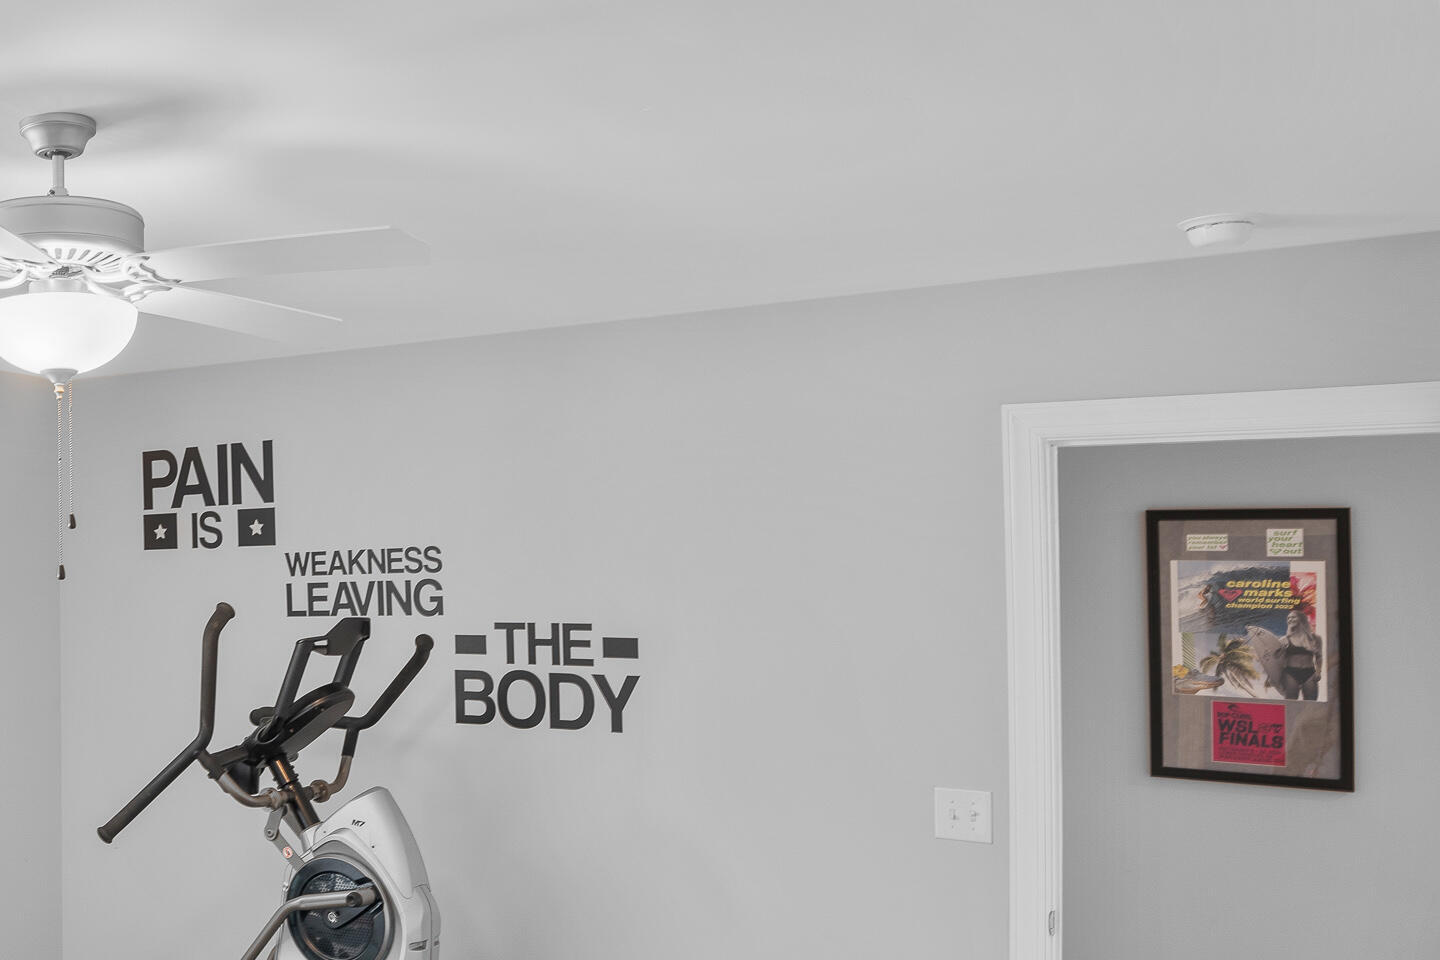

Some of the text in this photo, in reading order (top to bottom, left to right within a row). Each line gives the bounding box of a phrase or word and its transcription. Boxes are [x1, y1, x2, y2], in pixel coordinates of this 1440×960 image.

[142, 440, 275, 510] PAIN
[191, 511, 223, 549] IS
[285, 546, 443, 576] WEAKNESS
[286, 579, 444, 617] LEAVING
[1226, 579, 1291, 588] caroline
[1243, 588, 1293, 597] marks
[1265, 597, 1300, 605] surfing
[494, 622, 594, 667] THE
[455, 670, 640, 733] BODY
[1217, 719, 1259, 733] WSL
[1218, 732, 1284, 748] FINALS
